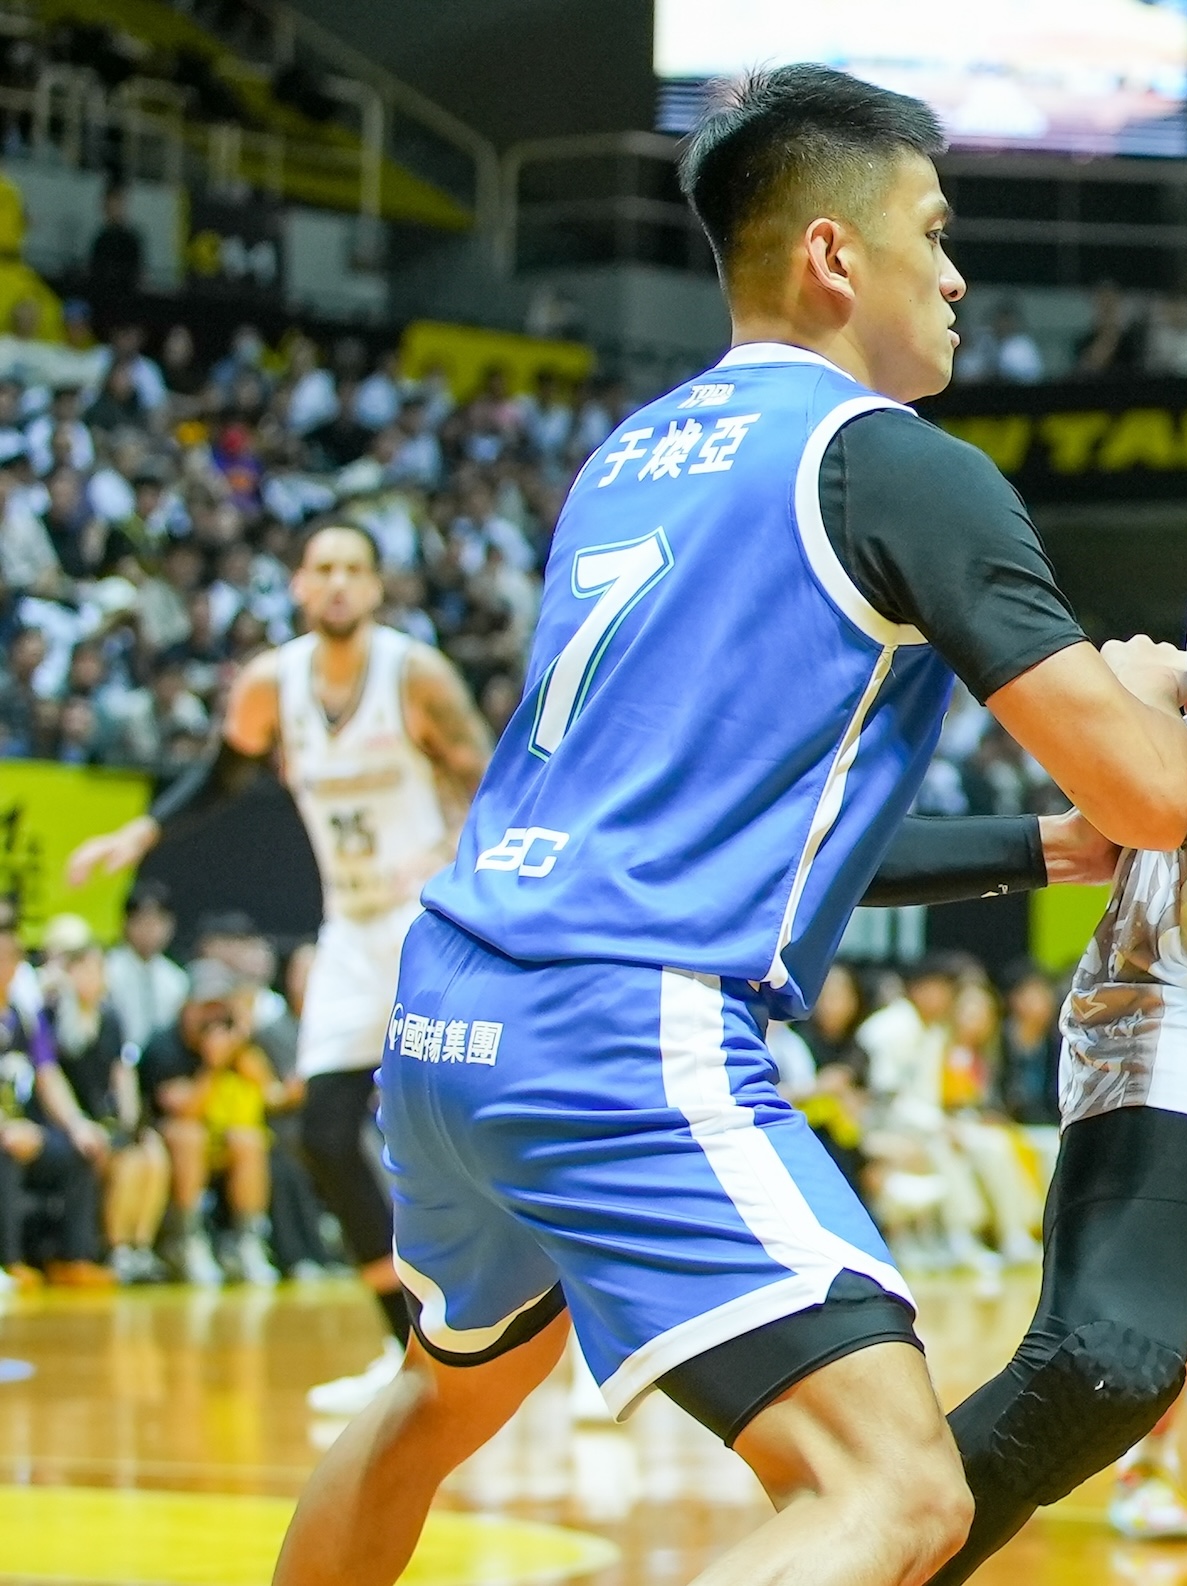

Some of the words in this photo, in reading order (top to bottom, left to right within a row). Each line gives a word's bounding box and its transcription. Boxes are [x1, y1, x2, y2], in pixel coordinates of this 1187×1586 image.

[528, 525, 675, 763] 7
[400, 1012, 504, 1067] 國揚集團
